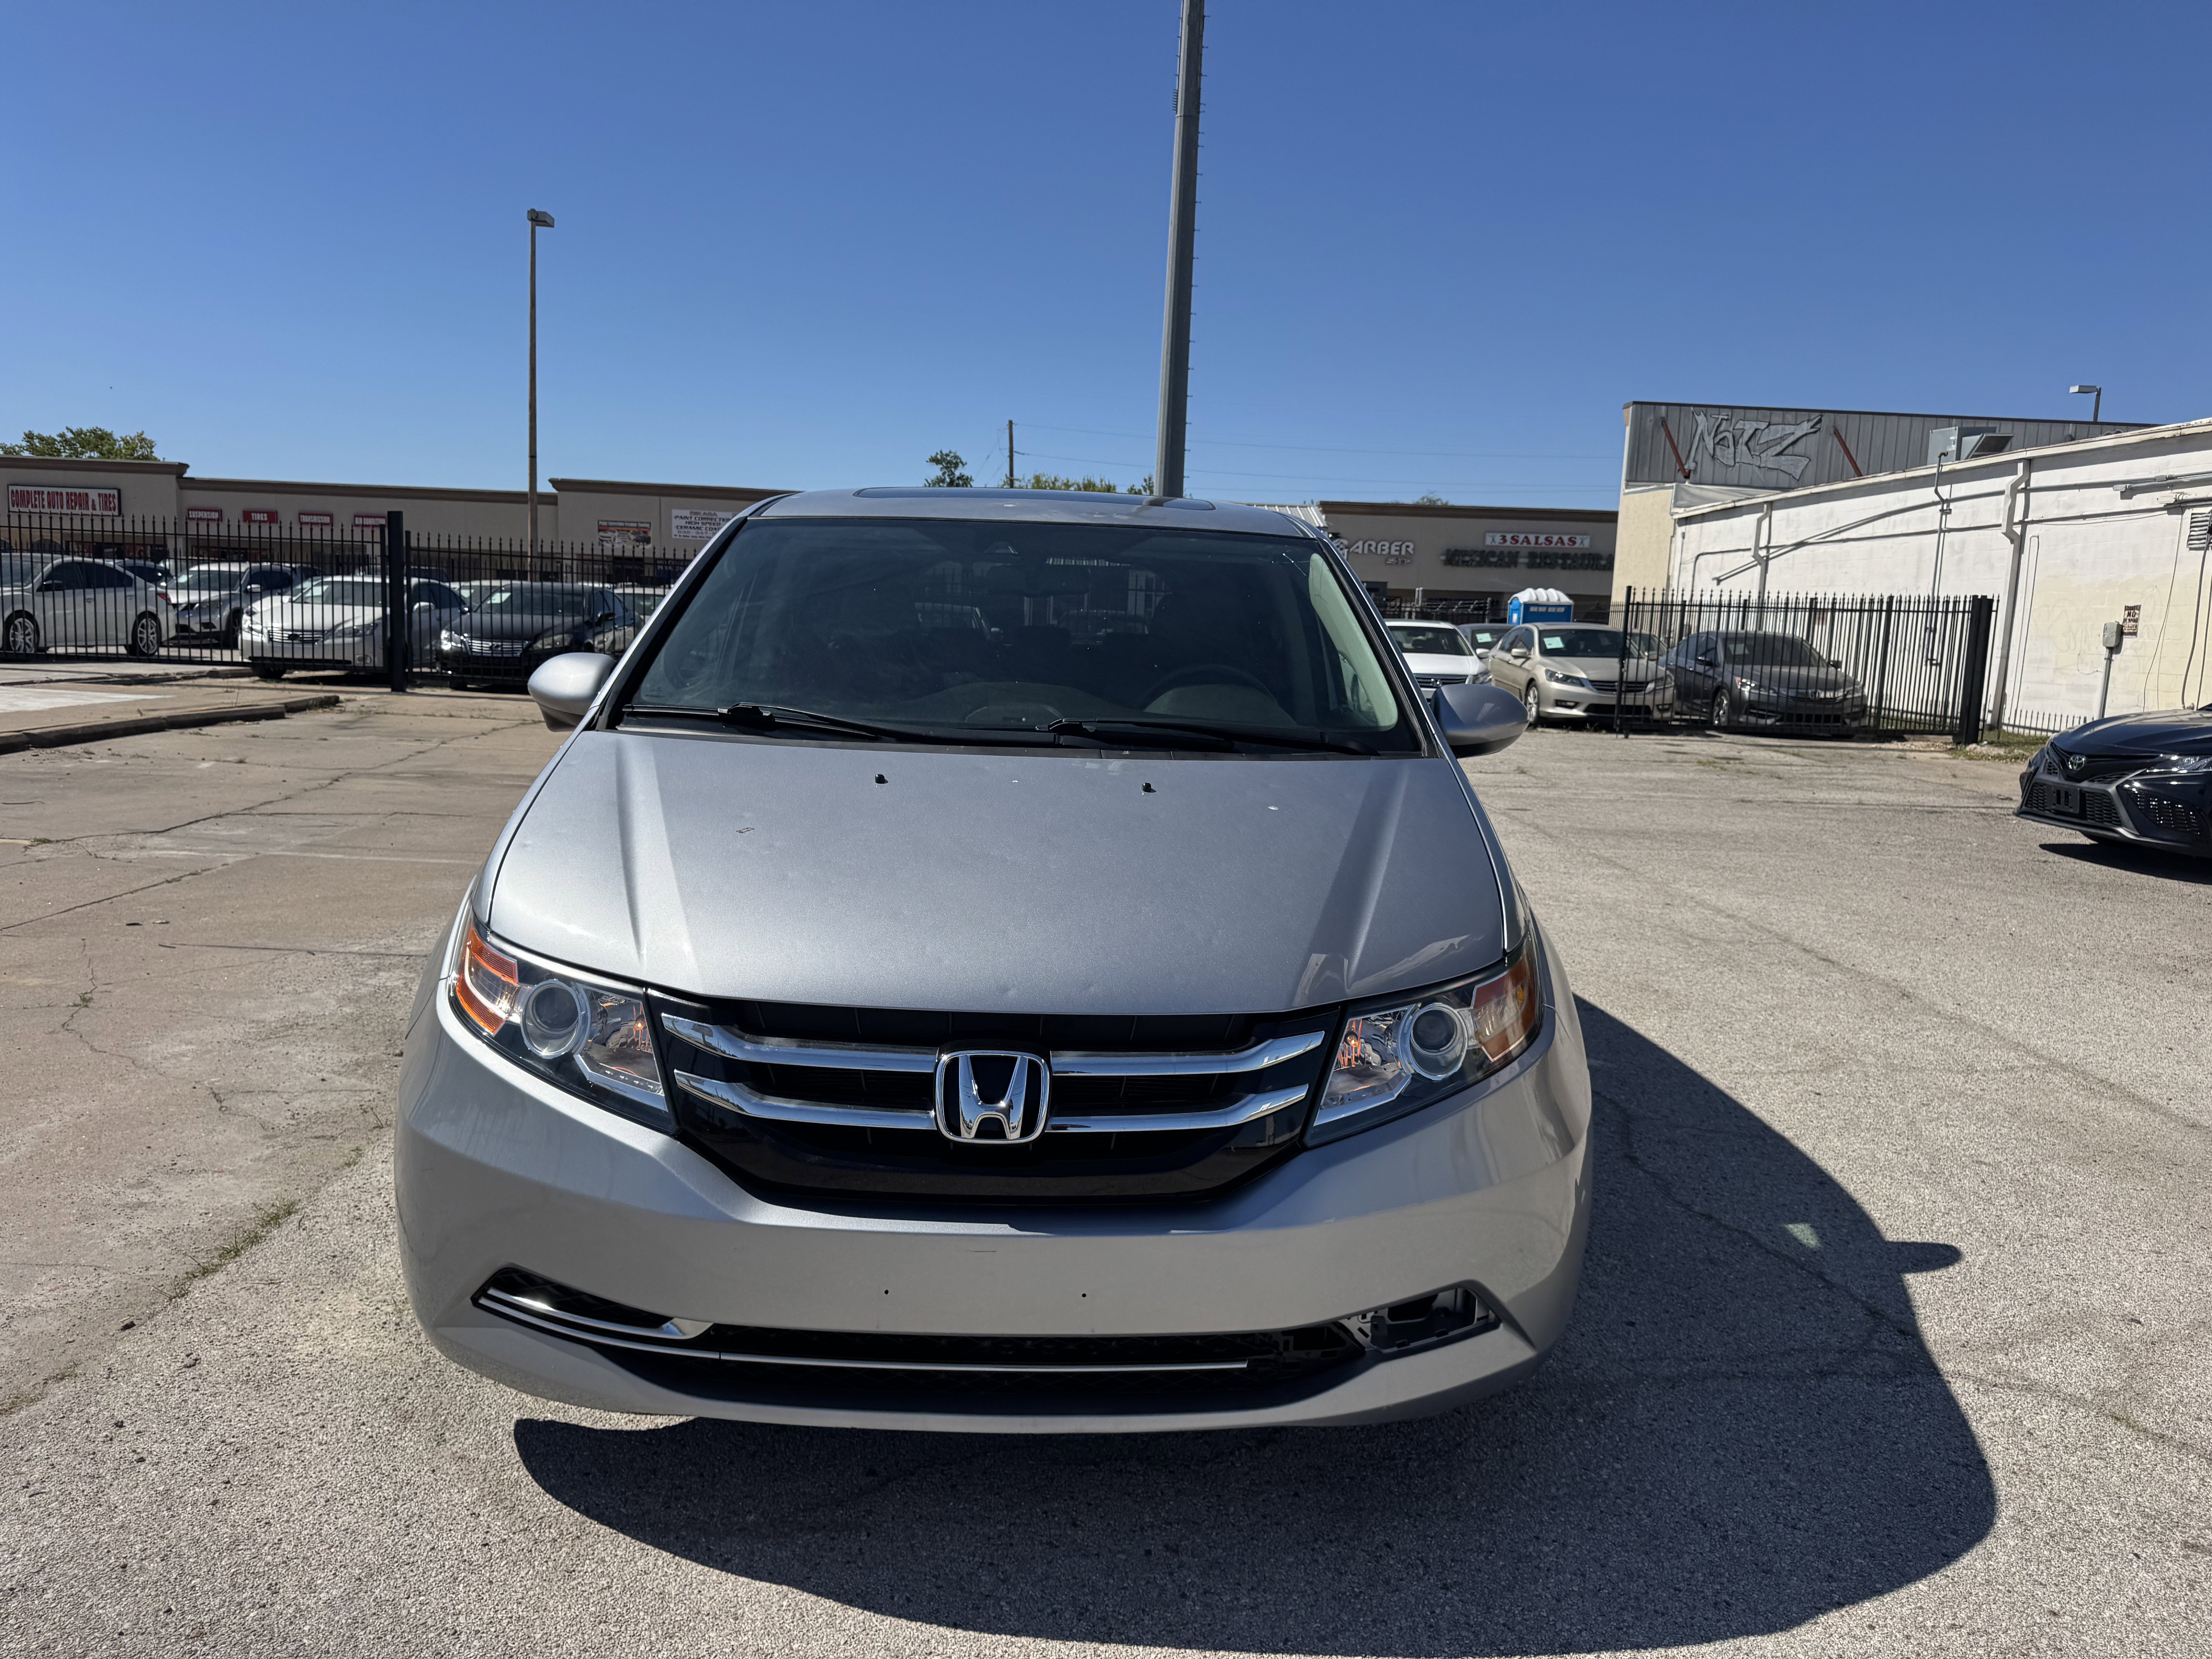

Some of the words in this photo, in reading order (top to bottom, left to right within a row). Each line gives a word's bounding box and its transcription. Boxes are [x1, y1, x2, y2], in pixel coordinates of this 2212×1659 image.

[11, 489, 45, 508] COMPLETE
[47, 491, 64, 510] AUTO
[65, 491, 89, 511] REPAIR
[91, 498, 96, 510] &
[98, 493, 116, 512] TIRES
[251, 512, 268, 521] TIRES
[1444, 548, 1520, 568] MEXICAN
